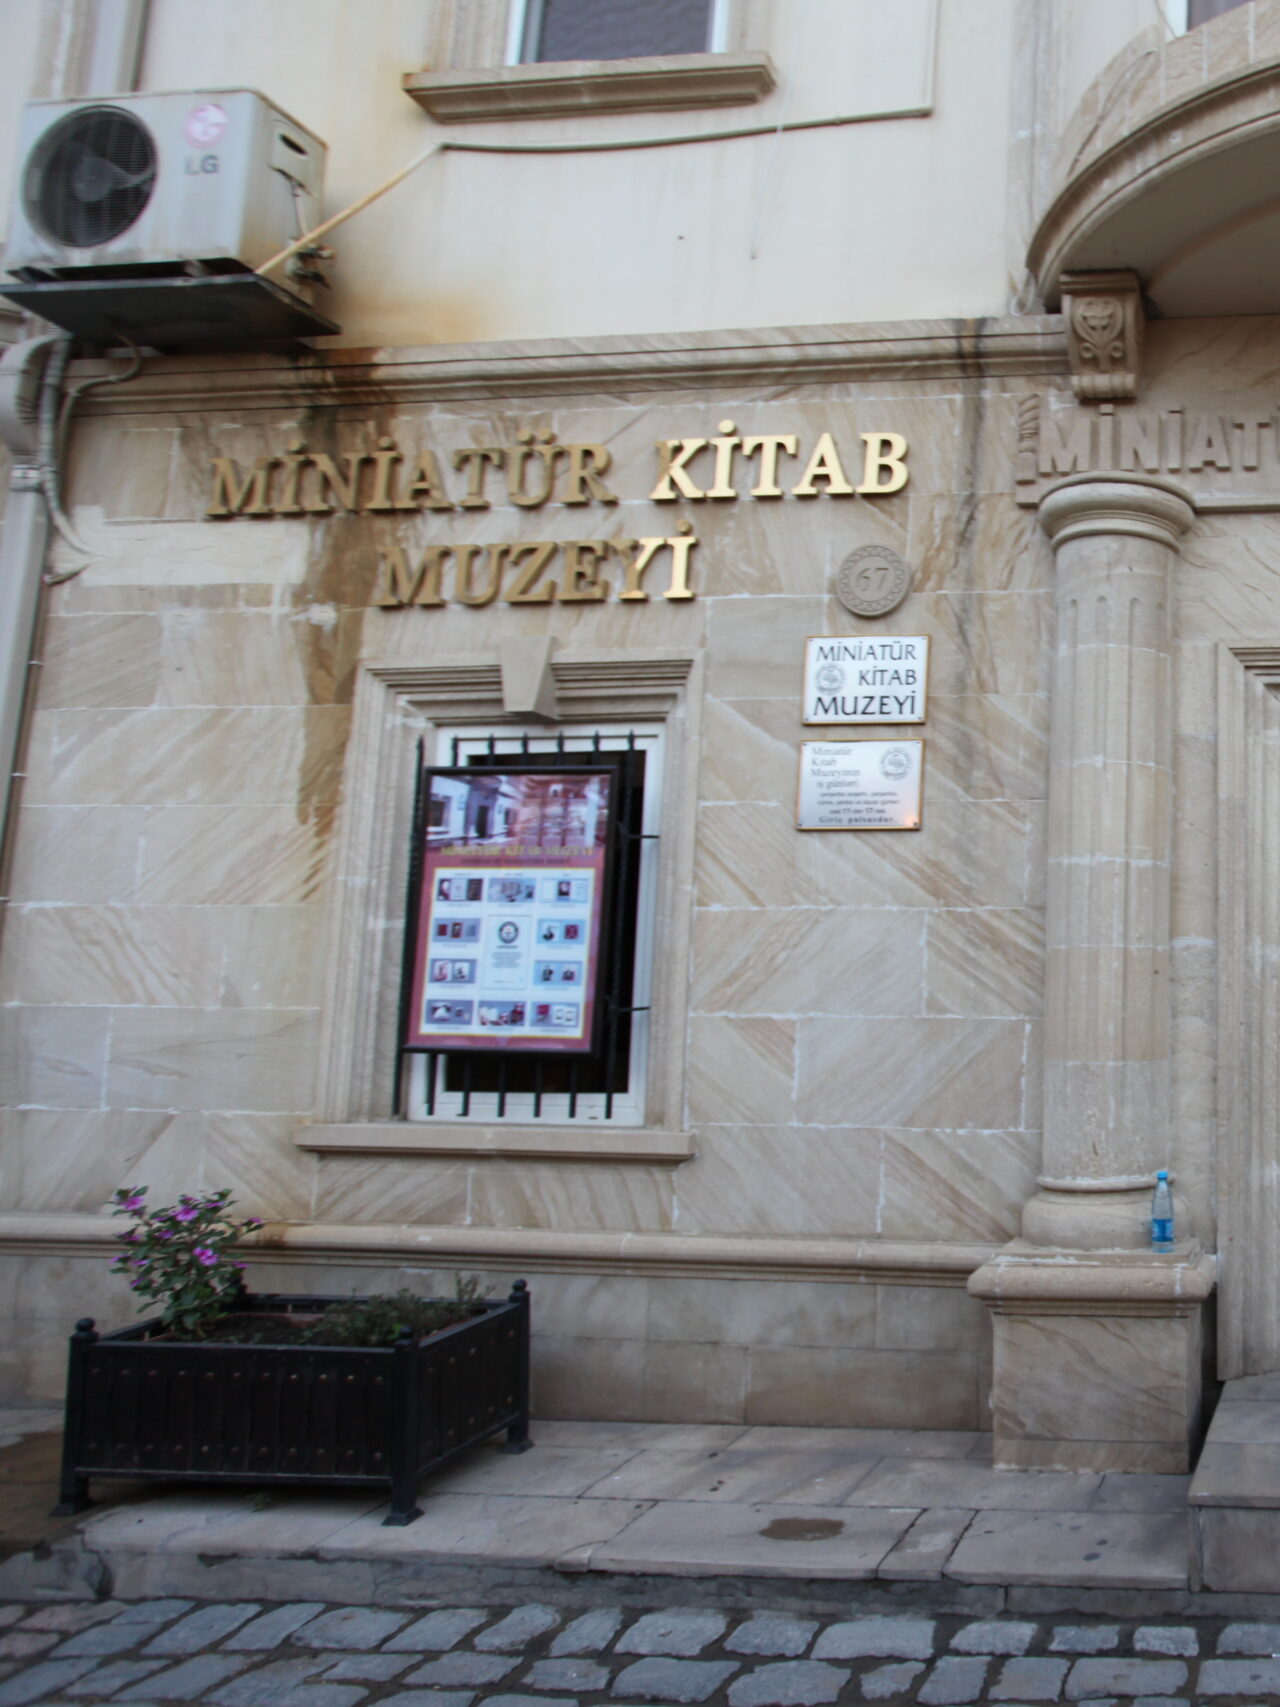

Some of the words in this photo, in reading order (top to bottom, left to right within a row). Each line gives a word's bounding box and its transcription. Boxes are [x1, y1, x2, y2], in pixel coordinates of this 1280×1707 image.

[183, 154, 220, 175] LG
[206, 428, 620, 517] MİNİATÜR
[649, 419, 910, 500] KİTAB
[378, 519, 697, 607] MUZEYİ
[855, 567, 890, 592] 67
[816, 641, 917, 662] MİNİATÜR
[858, 665, 918, 686] KİTAB
[813, 690, 916, 716] MUZEYİ
